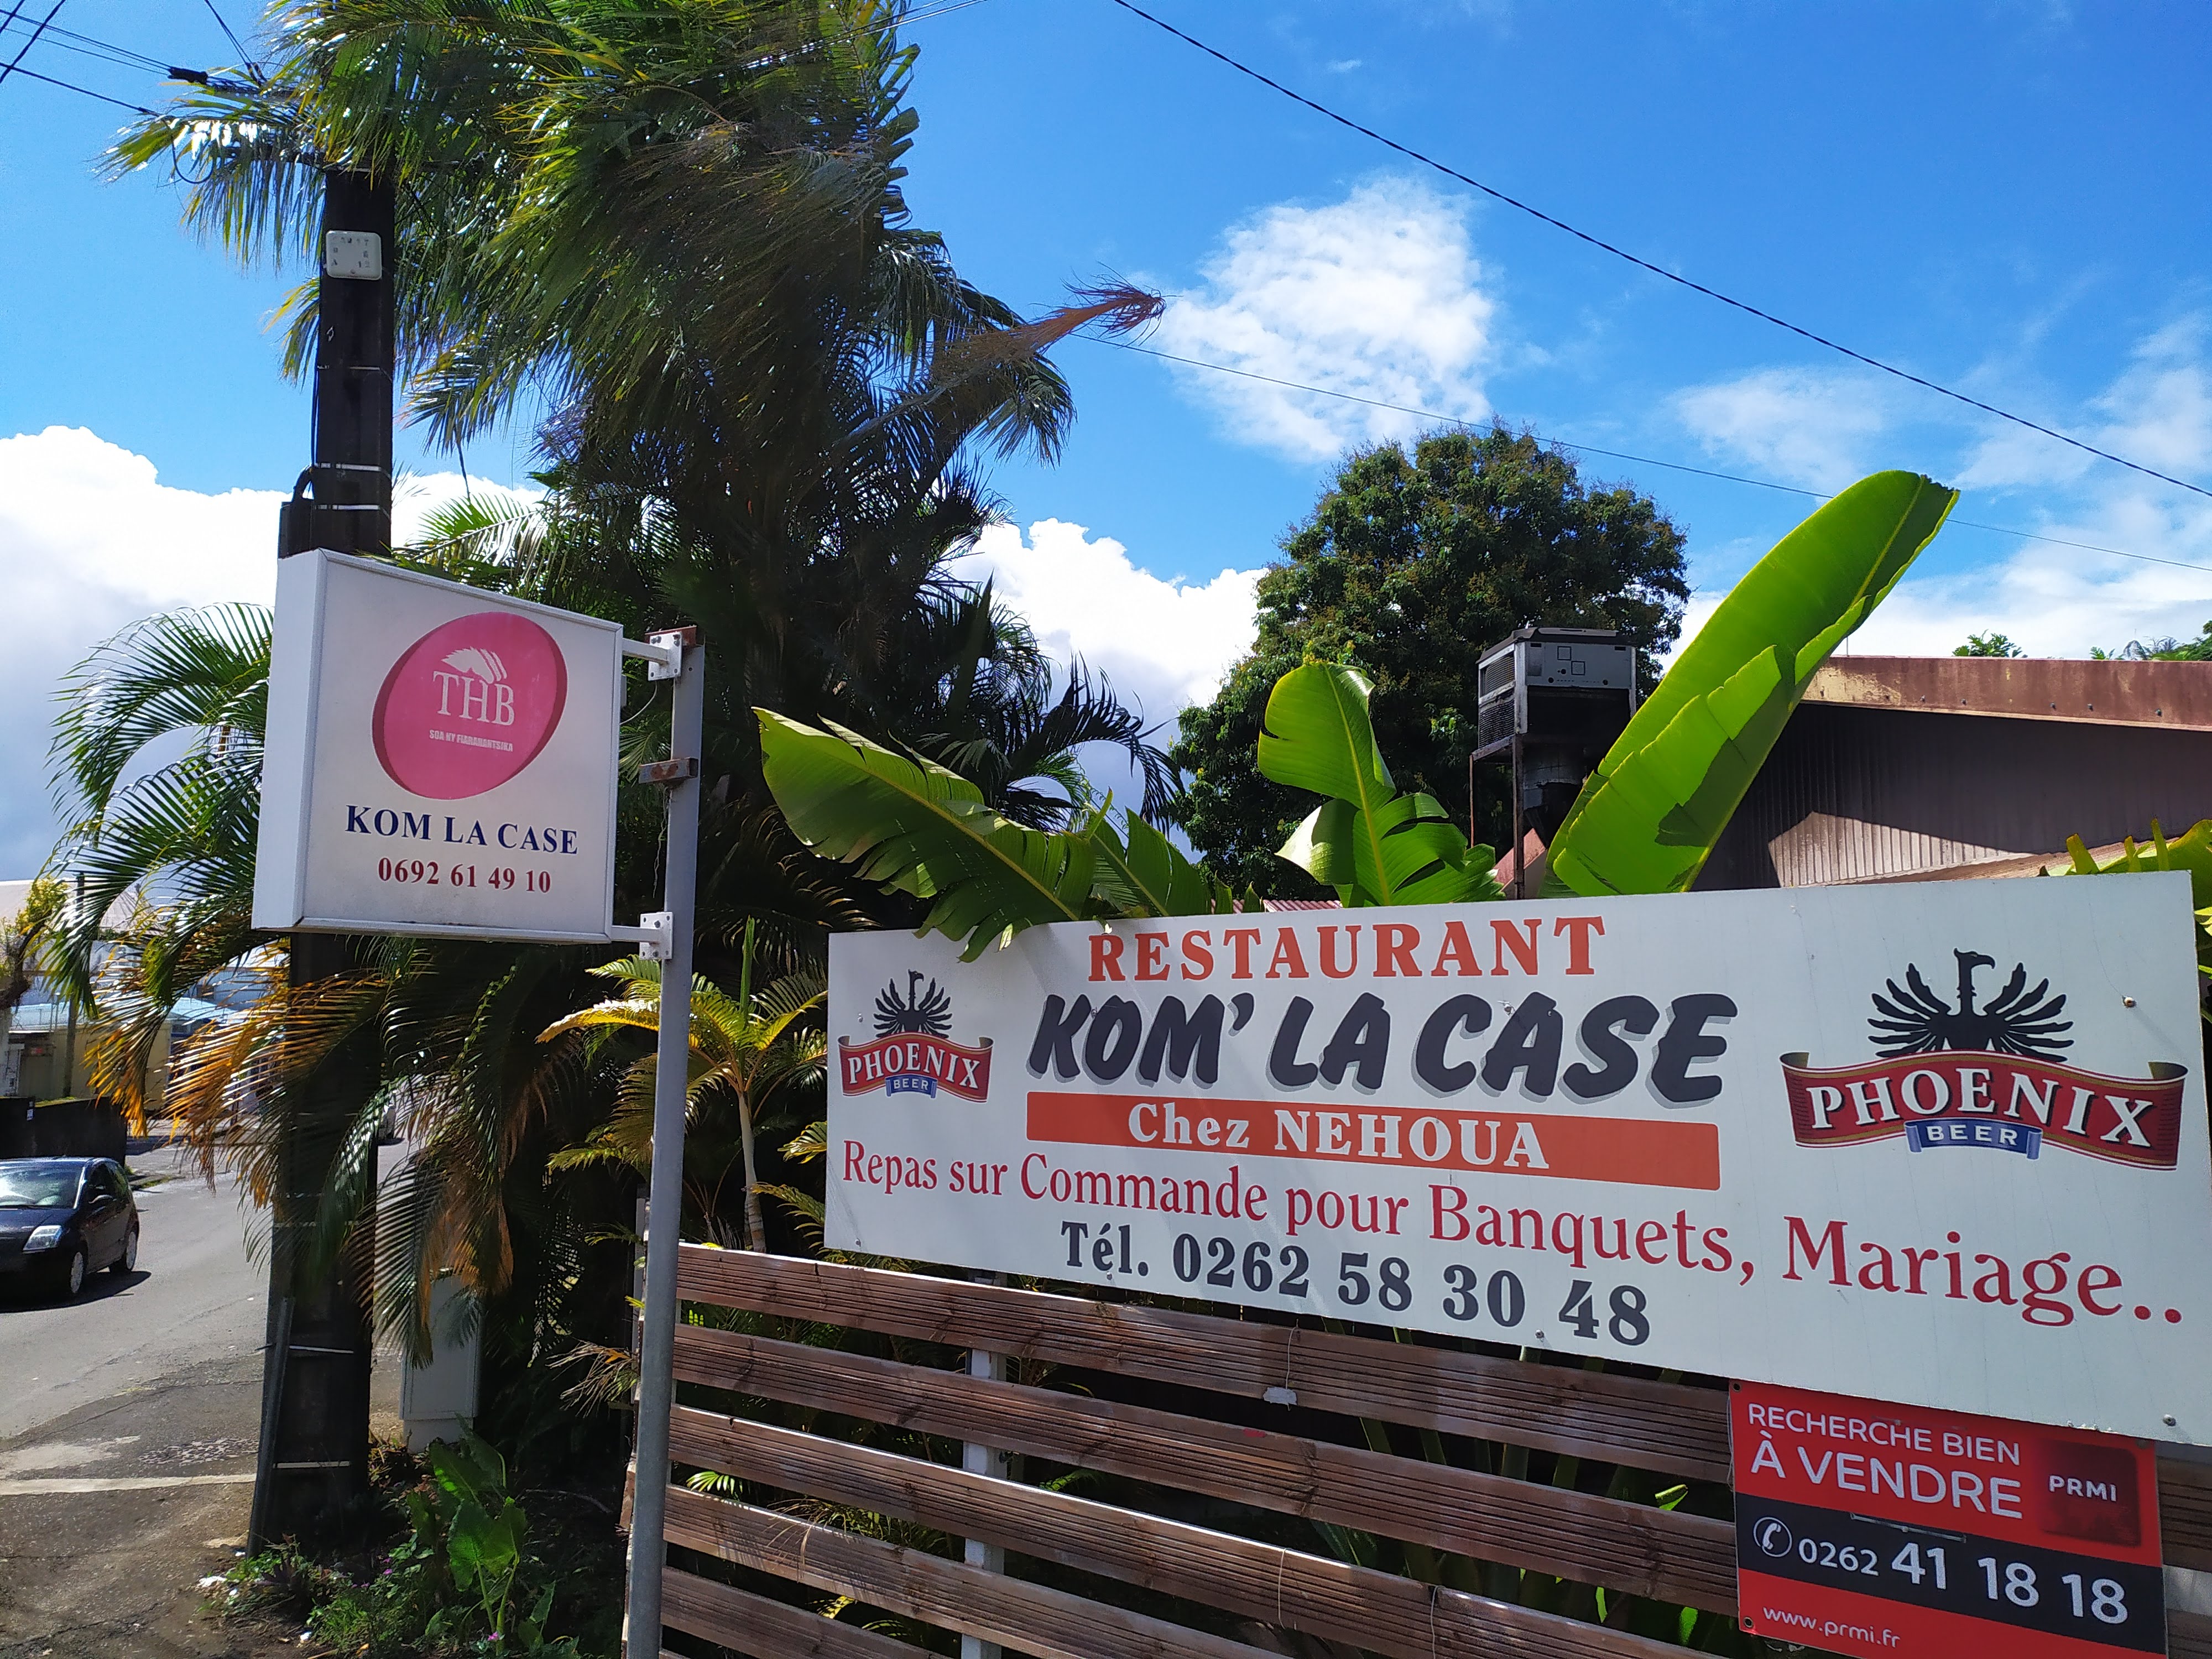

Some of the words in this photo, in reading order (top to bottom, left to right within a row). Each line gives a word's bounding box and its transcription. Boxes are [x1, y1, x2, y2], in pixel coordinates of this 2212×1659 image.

[432, 670, 515, 726] THB
[429, 729, 445, 741] SOA
[345, 805, 432, 840] KOM
[443, 816, 488, 846] LA
[498, 823, 578, 854] CASE
[378, 857, 440, 885] 0692
[451, 864, 477, 888] 61
[488, 867, 515, 890] 49
[526, 870, 551, 894] 10
[1088, 916, 1606, 982] RESTAURANT
[847, 1042, 981, 1090] PHOENIX
[1266, 992, 1391, 1095] LA
[1412, 992, 1738, 1109] CASE
[893, 1078, 930, 1092] BEER
[1806, 1067, 2154, 1148] PHOENIX
[1129, 1103, 1251, 1149] Chez
[1274, 1109, 1550, 1170] NEHOUA
[1926, 1125, 2018, 1146] BEER
[843, 1141, 938, 1195] Repas
[949, 1160, 1009, 1197] sur
[1020, 1153, 1268, 1222] Commande
[1285, 1188, 1409, 1237] pour
[1428, 1184, 1755, 1286] Banquets,
[1782, 1216, 2182, 1327] Mariage..
[1061, 1220, 1150, 1276] Tél.
[1172, 1233, 1310, 1298] 0262
[1338, 1252, 1412, 1312] 58
[1442, 1264, 1526, 1327] 30
[1558, 1280, 1650, 1347] 48
[1748, 1403, 1933, 1453] RECHERCHE
[1943, 1432, 2021, 1466] BIEN
[1750, 1431, 1787, 1479] À
[1797, 1446, 2023, 1520] VENDRE
[2049, 1475, 2117, 1502] PRMI
[1798, 1538, 1879, 1577] 0262
[1891, 1542, 1947, 1590] 41
[1978, 1557, 2039, 1608] 18
[2062, 1573, 2129, 1625] 18
[1762, 1606, 1901, 1648] www.prmi.fr
